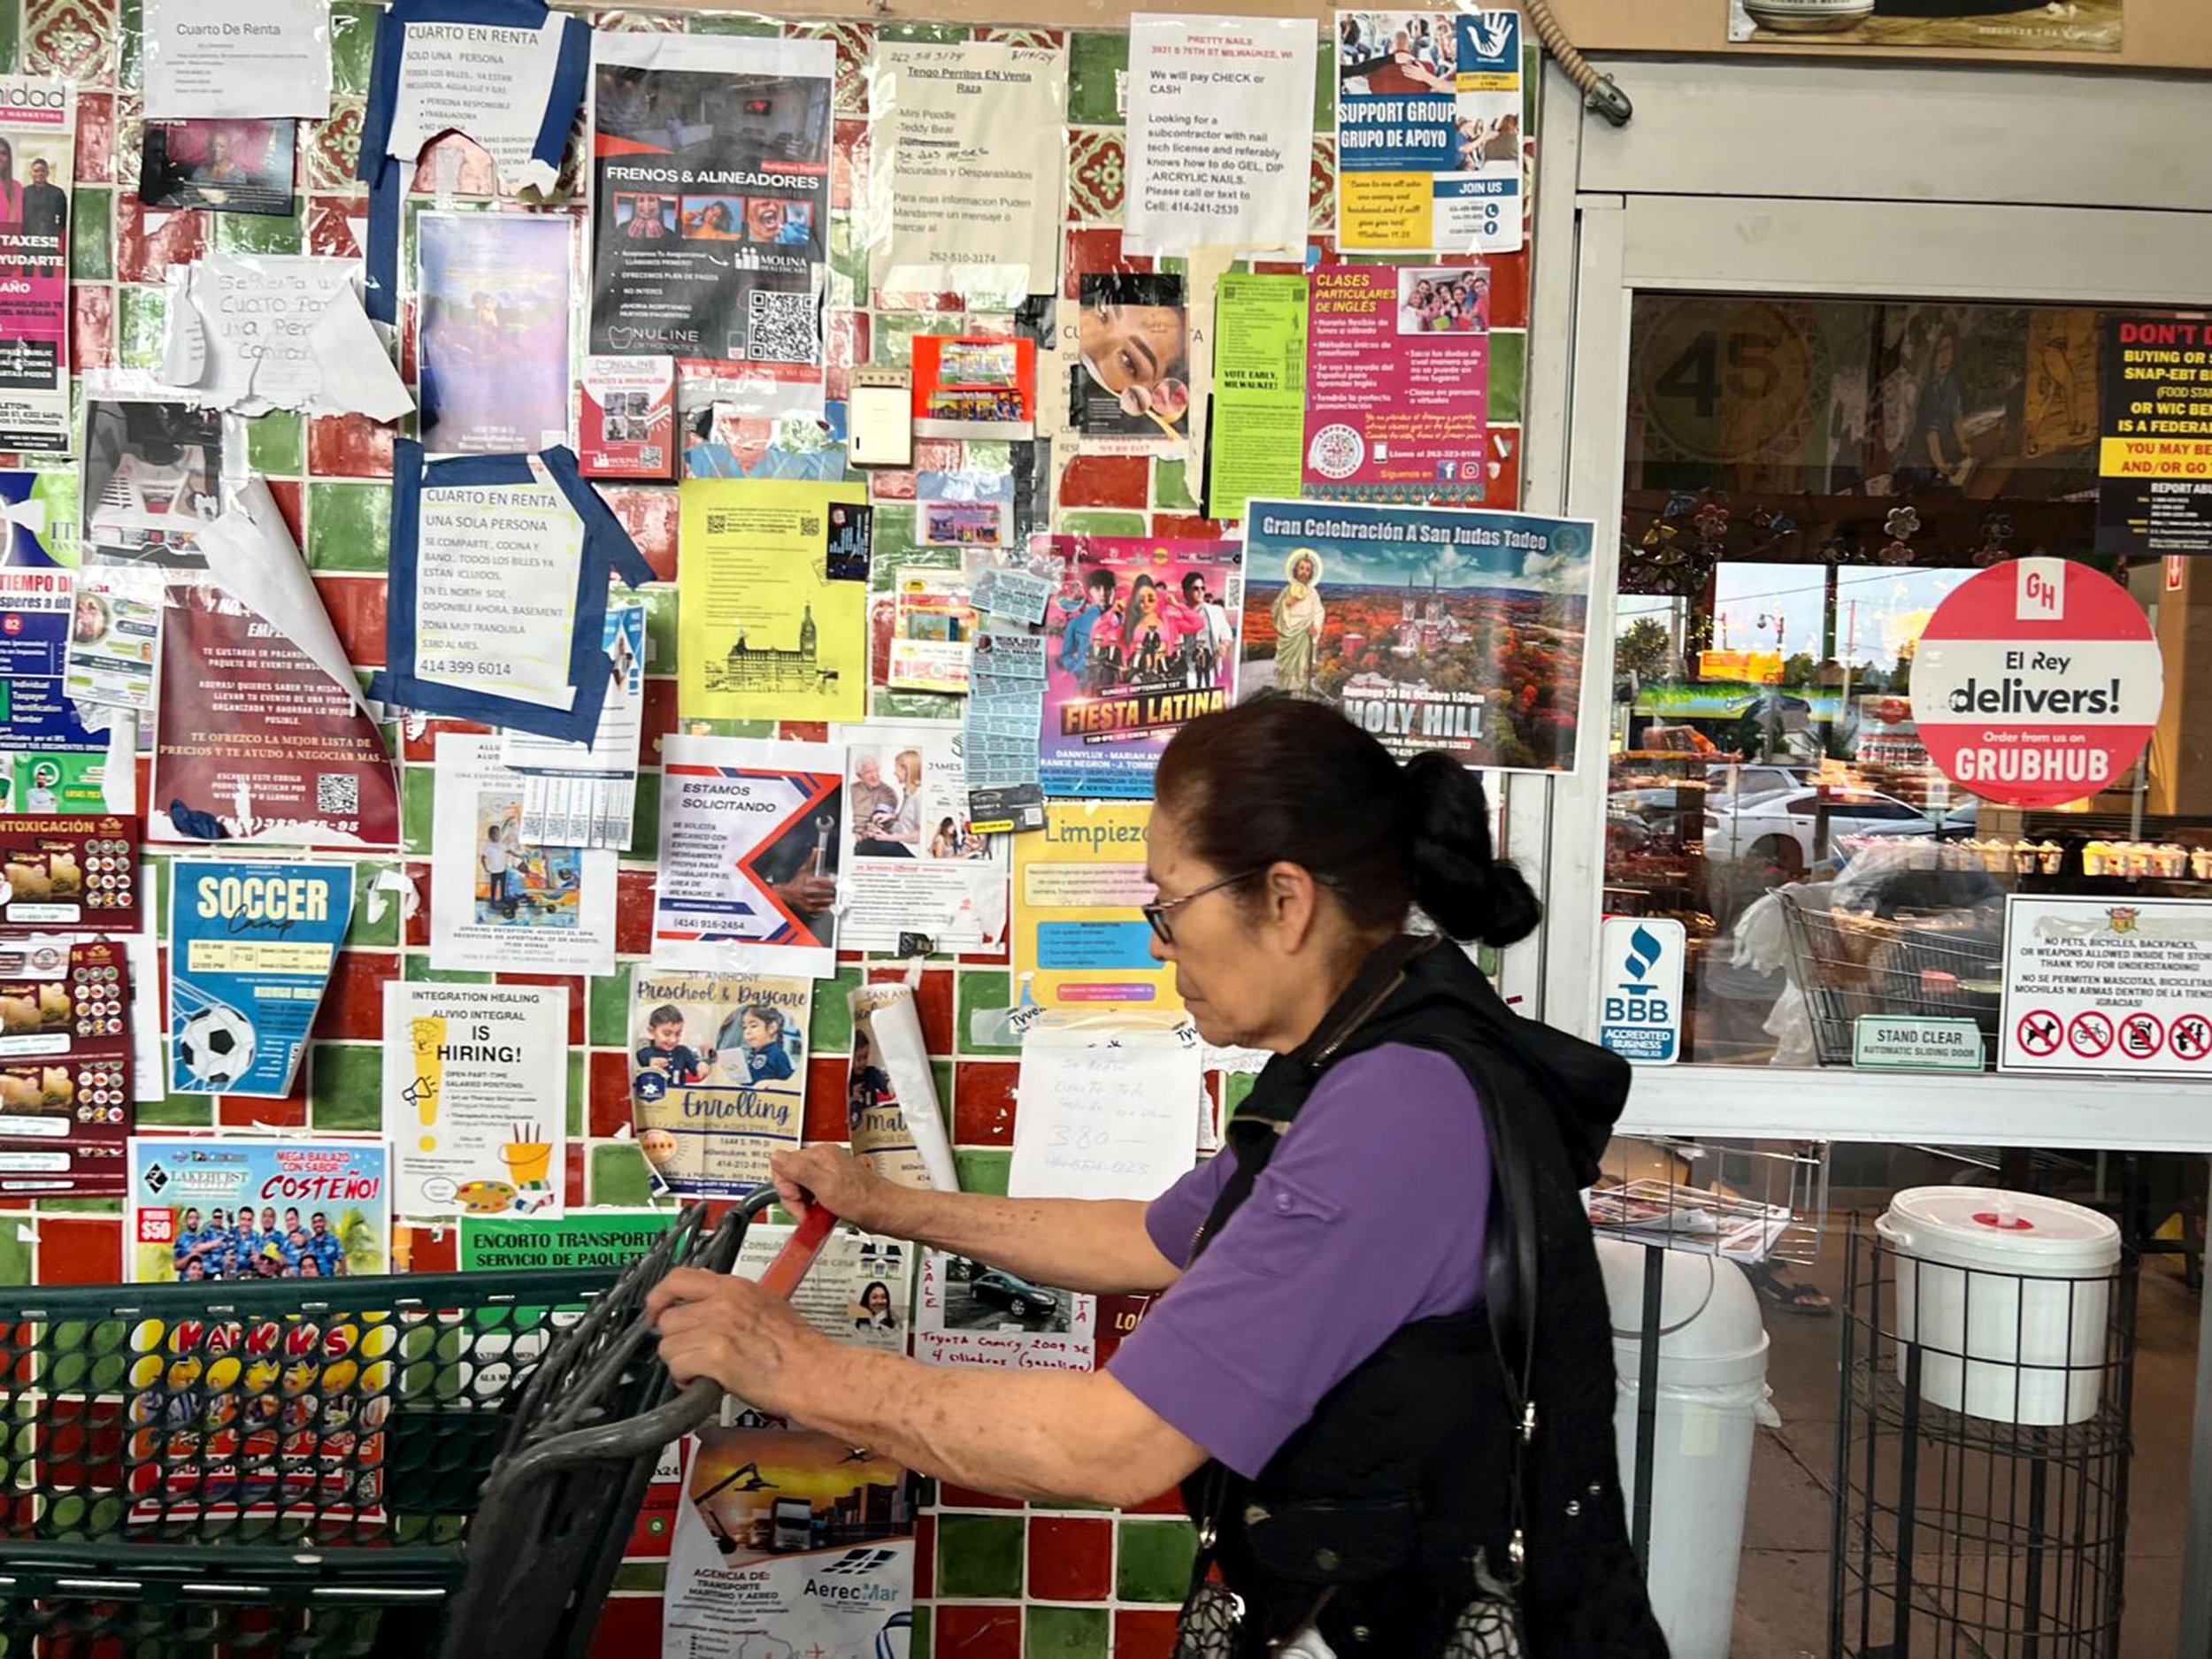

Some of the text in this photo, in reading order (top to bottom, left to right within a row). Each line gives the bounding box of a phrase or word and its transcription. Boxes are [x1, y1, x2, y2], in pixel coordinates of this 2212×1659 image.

[176, 23, 281, 36] Cuarto De Renta
[408, 27, 539, 45] CUARTO EN RENTA
[1187, 35, 1224, 44] PRETTY
[406, 51, 504, 64] SOLO UNA PERSONA
[908, 66, 1032, 82] Tengo Perritos EN Venta
[1190, 73, 1208, 83] pay
[1211, 73, 1250, 83] CHECK
[956, 84, 981, 94] Raza
[1340, 102, 1455, 123] SUPPORT GROUP
[1148, 115, 1191, 125] Looking
[1148, 130, 1221, 139] subcontractor
[1249, 133, 1268, 142] nail
[1340, 130, 1447, 148] GRUPO DE APOYO
[607, 166, 818, 188] FRENOS & ALINEADORES
[1152, 173, 1208, 183] ARCRYLIC
[1460, 182, 1502, 193] JOIN US
[760, 255, 807, 267] MOLINA
[1317, 274, 1370, 286] CLASES
[1316, 289, 1396, 299] PARTICULARES
[631, 328, 700, 342] NULINE
[2120, 324, 2197, 344] DON'T
[2124, 350, 2205, 364] BUYING OR
[1224, 371, 1246, 380] VOTE
[2124, 368, 2196, 380] SNAP-EBT
[2131, 403, 2185, 414] OR WIC
[2118, 420, 2133, 431] IS
[2137, 421, 2147, 432] A
[2126, 443, 2190, 454] YOU MAY
[2121, 462, 2207, 474] AND/OR GO
[426, 489, 557, 509] CUARTO EN RENTA
[426, 515, 547, 532] UNA SOLA PERSONA
[1263, 517, 1547, 550] Gran Celebración A San Judas Tadeo
[2026, 572, 2055, 610] GH
[420, 660, 511, 675] 414 399 6014
[2006, 651, 2070, 674] El Rey
[1950, 678, 2120, 714] delivers!
[1064, 689, 1224, 733] FIESTA LATINA
[1346, 701, 1483, 739] HOLY HILL
[191, 732, 205, 741] TE
[265, 734, 280, 743] LA
[283, 736, 319, 746] MEJOR
[322, 738, 354, 747] LISTA
[356, 738, 372, 748] DE
[1983, 731, 2085, 743] Order from us on
[1955, 748, 2108, 781] GRUBHUB
[683, 783, 750, 795] ESTAMOS
[682, 799, 776, 812] SOLICITANDO
[197, 876, 328, 920] SOCCER
[2045, 937, 2057, 948] NO
[412, 991, 540, 1003] INTEGRATION HEALING
[636, 981, 806, 1012] Preschool & Daycare
[471, 1011, 525, 1020] INTEGRAL
[1605, 998, 1668, 1022] BBB
[472, 1025, 490, 1041] IS
[1605, 1029, 1670, 1040] ACCREDITED
[1877, 1030, 1962, 1045] STAND CLEAR
[1612, 1041, 1662, 1049] BUSINESS
[1863, 1046, 1975, 1057] AUTOMATIC SLIDING DOOR
[437, 1045, 521, 1063] HIRING!
[681, 1091, 789, 1123] Enrolling
[277, 1152, 306, 1161] MEGA
[171, 1171, 249, 1182] LAKEHURST
[261, 1171, 380, 1200] COSTEÑO!
[141, 1220, 171, 1240] $50
[473, 1233, 550, 1248] ENCORTO
[477, 1254, 547, 1267] SERVICIO
[553, 1254, 572, 1266] DE
[1074, 1344, 1089, 1353] SE
[694, 1569, 770, 1580] AGENCIA DE:
